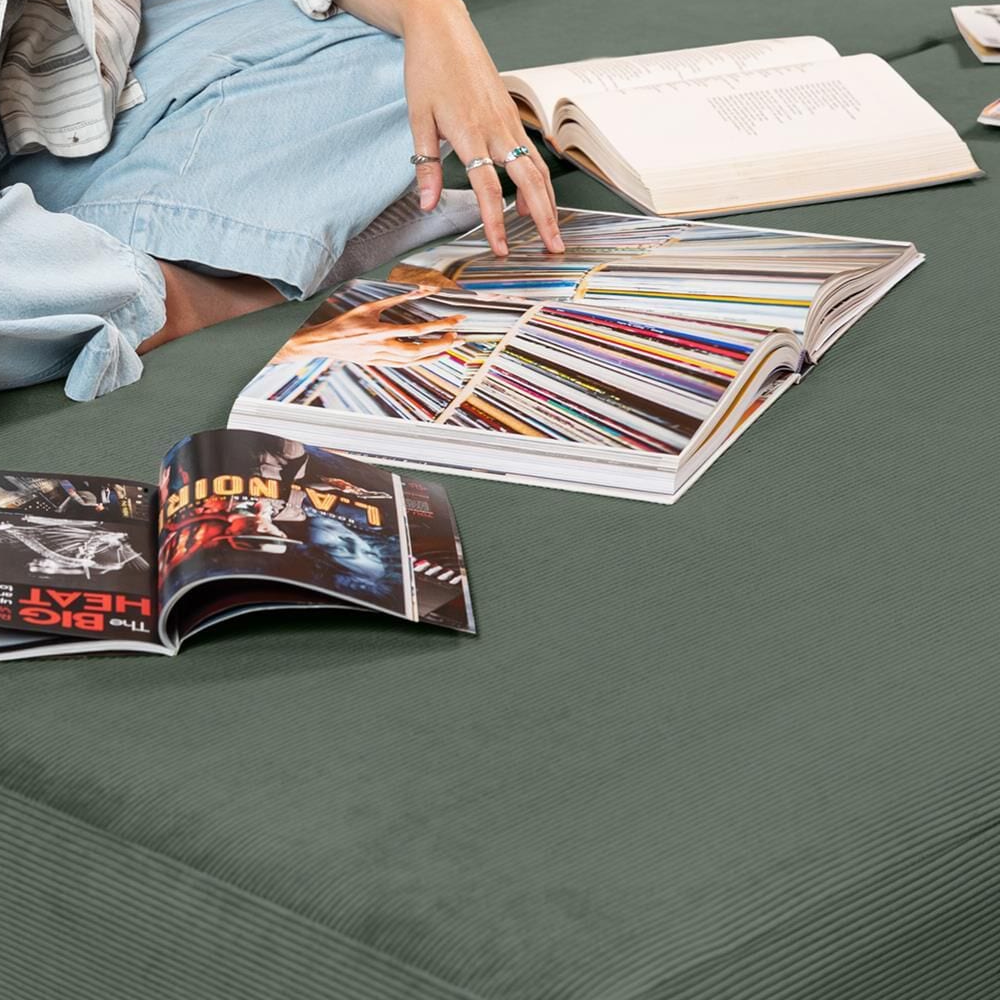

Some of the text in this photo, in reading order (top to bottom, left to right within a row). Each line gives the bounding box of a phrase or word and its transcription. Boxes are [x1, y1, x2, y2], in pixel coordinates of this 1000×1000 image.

[158, 475, 280, 532] NOIR
[19, 587, 151, 616] HEAT
[19, 607, 151, 633] The BIG
